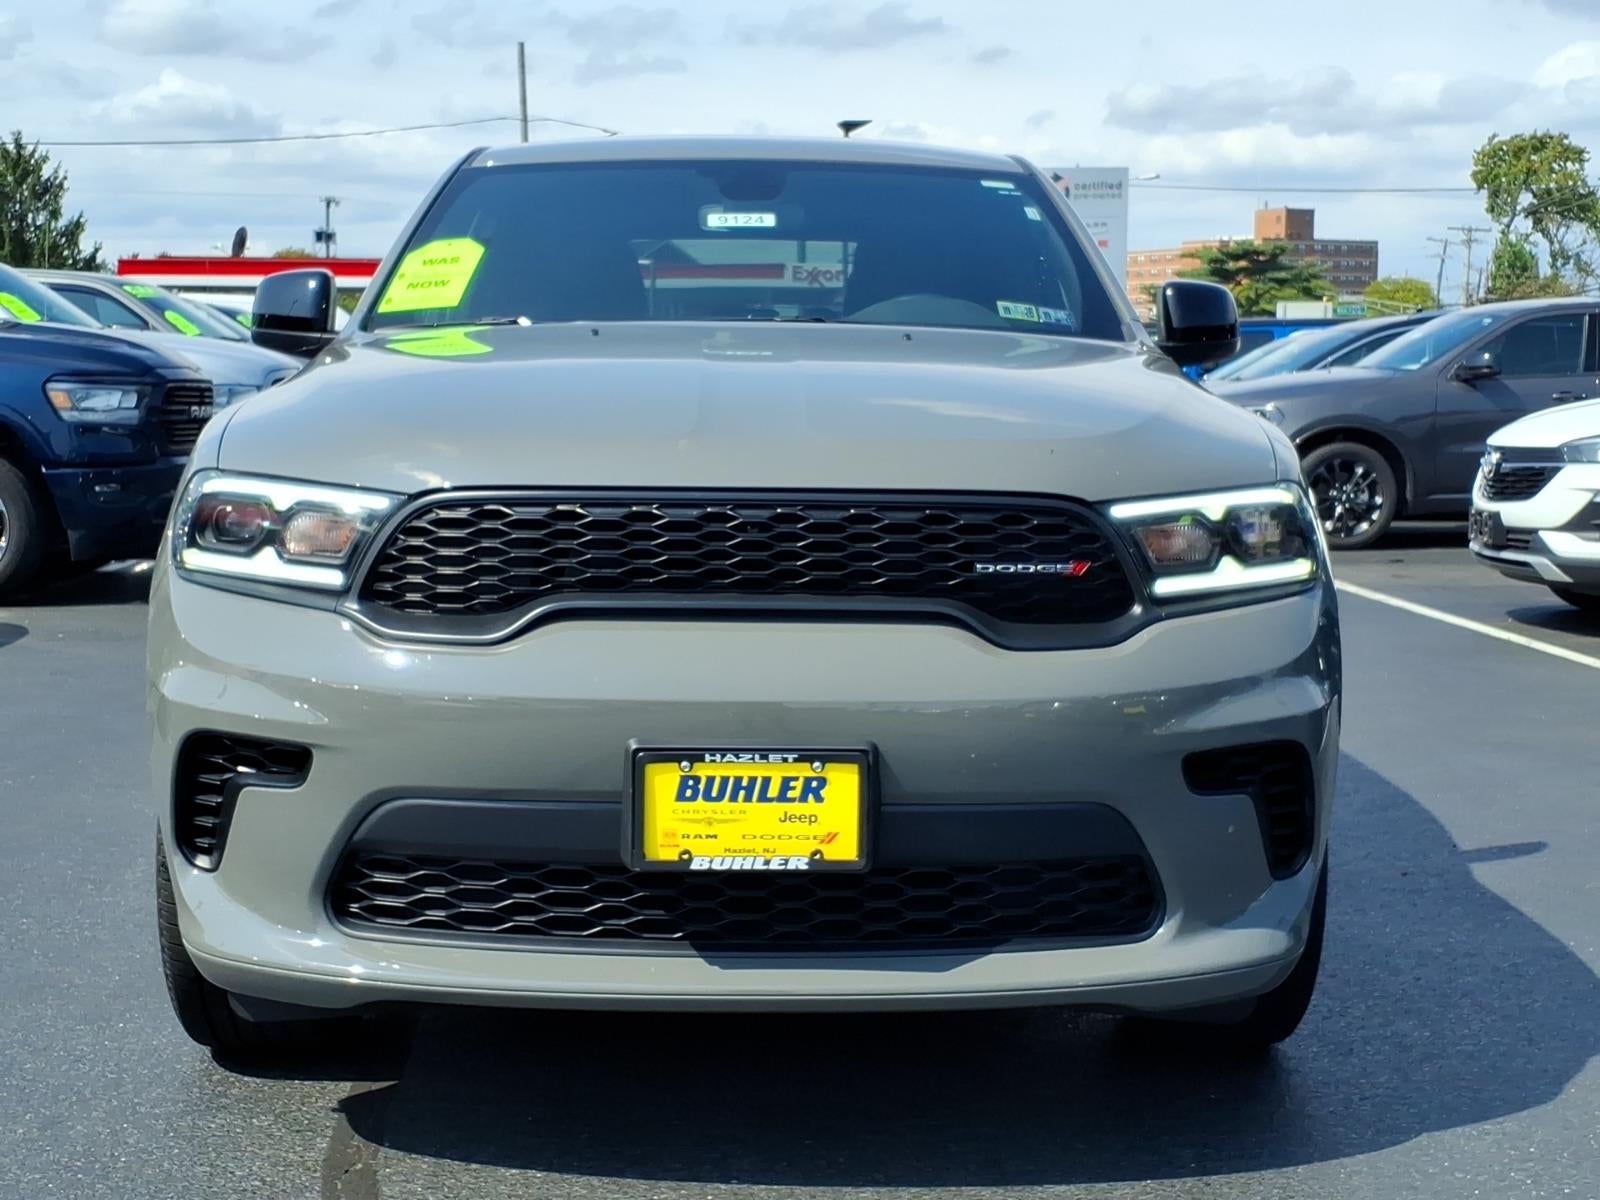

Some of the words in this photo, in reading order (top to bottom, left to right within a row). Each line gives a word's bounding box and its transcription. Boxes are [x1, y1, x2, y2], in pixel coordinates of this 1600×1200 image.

[1073, 181, 1122, 190] certified
[718, 215, 765, 224] 9124
[422, 257, 460, 266] WAS
[406, 280, 450, 289] NOW
[976, 564, 1074, 572] DODGE
[704, 753, 799, 763] HAZLET
[674, 775, 827, 803] BUHLER
[778, 811, 818, 826] Jeep
[689, 856, 809, 870] BUHLER
